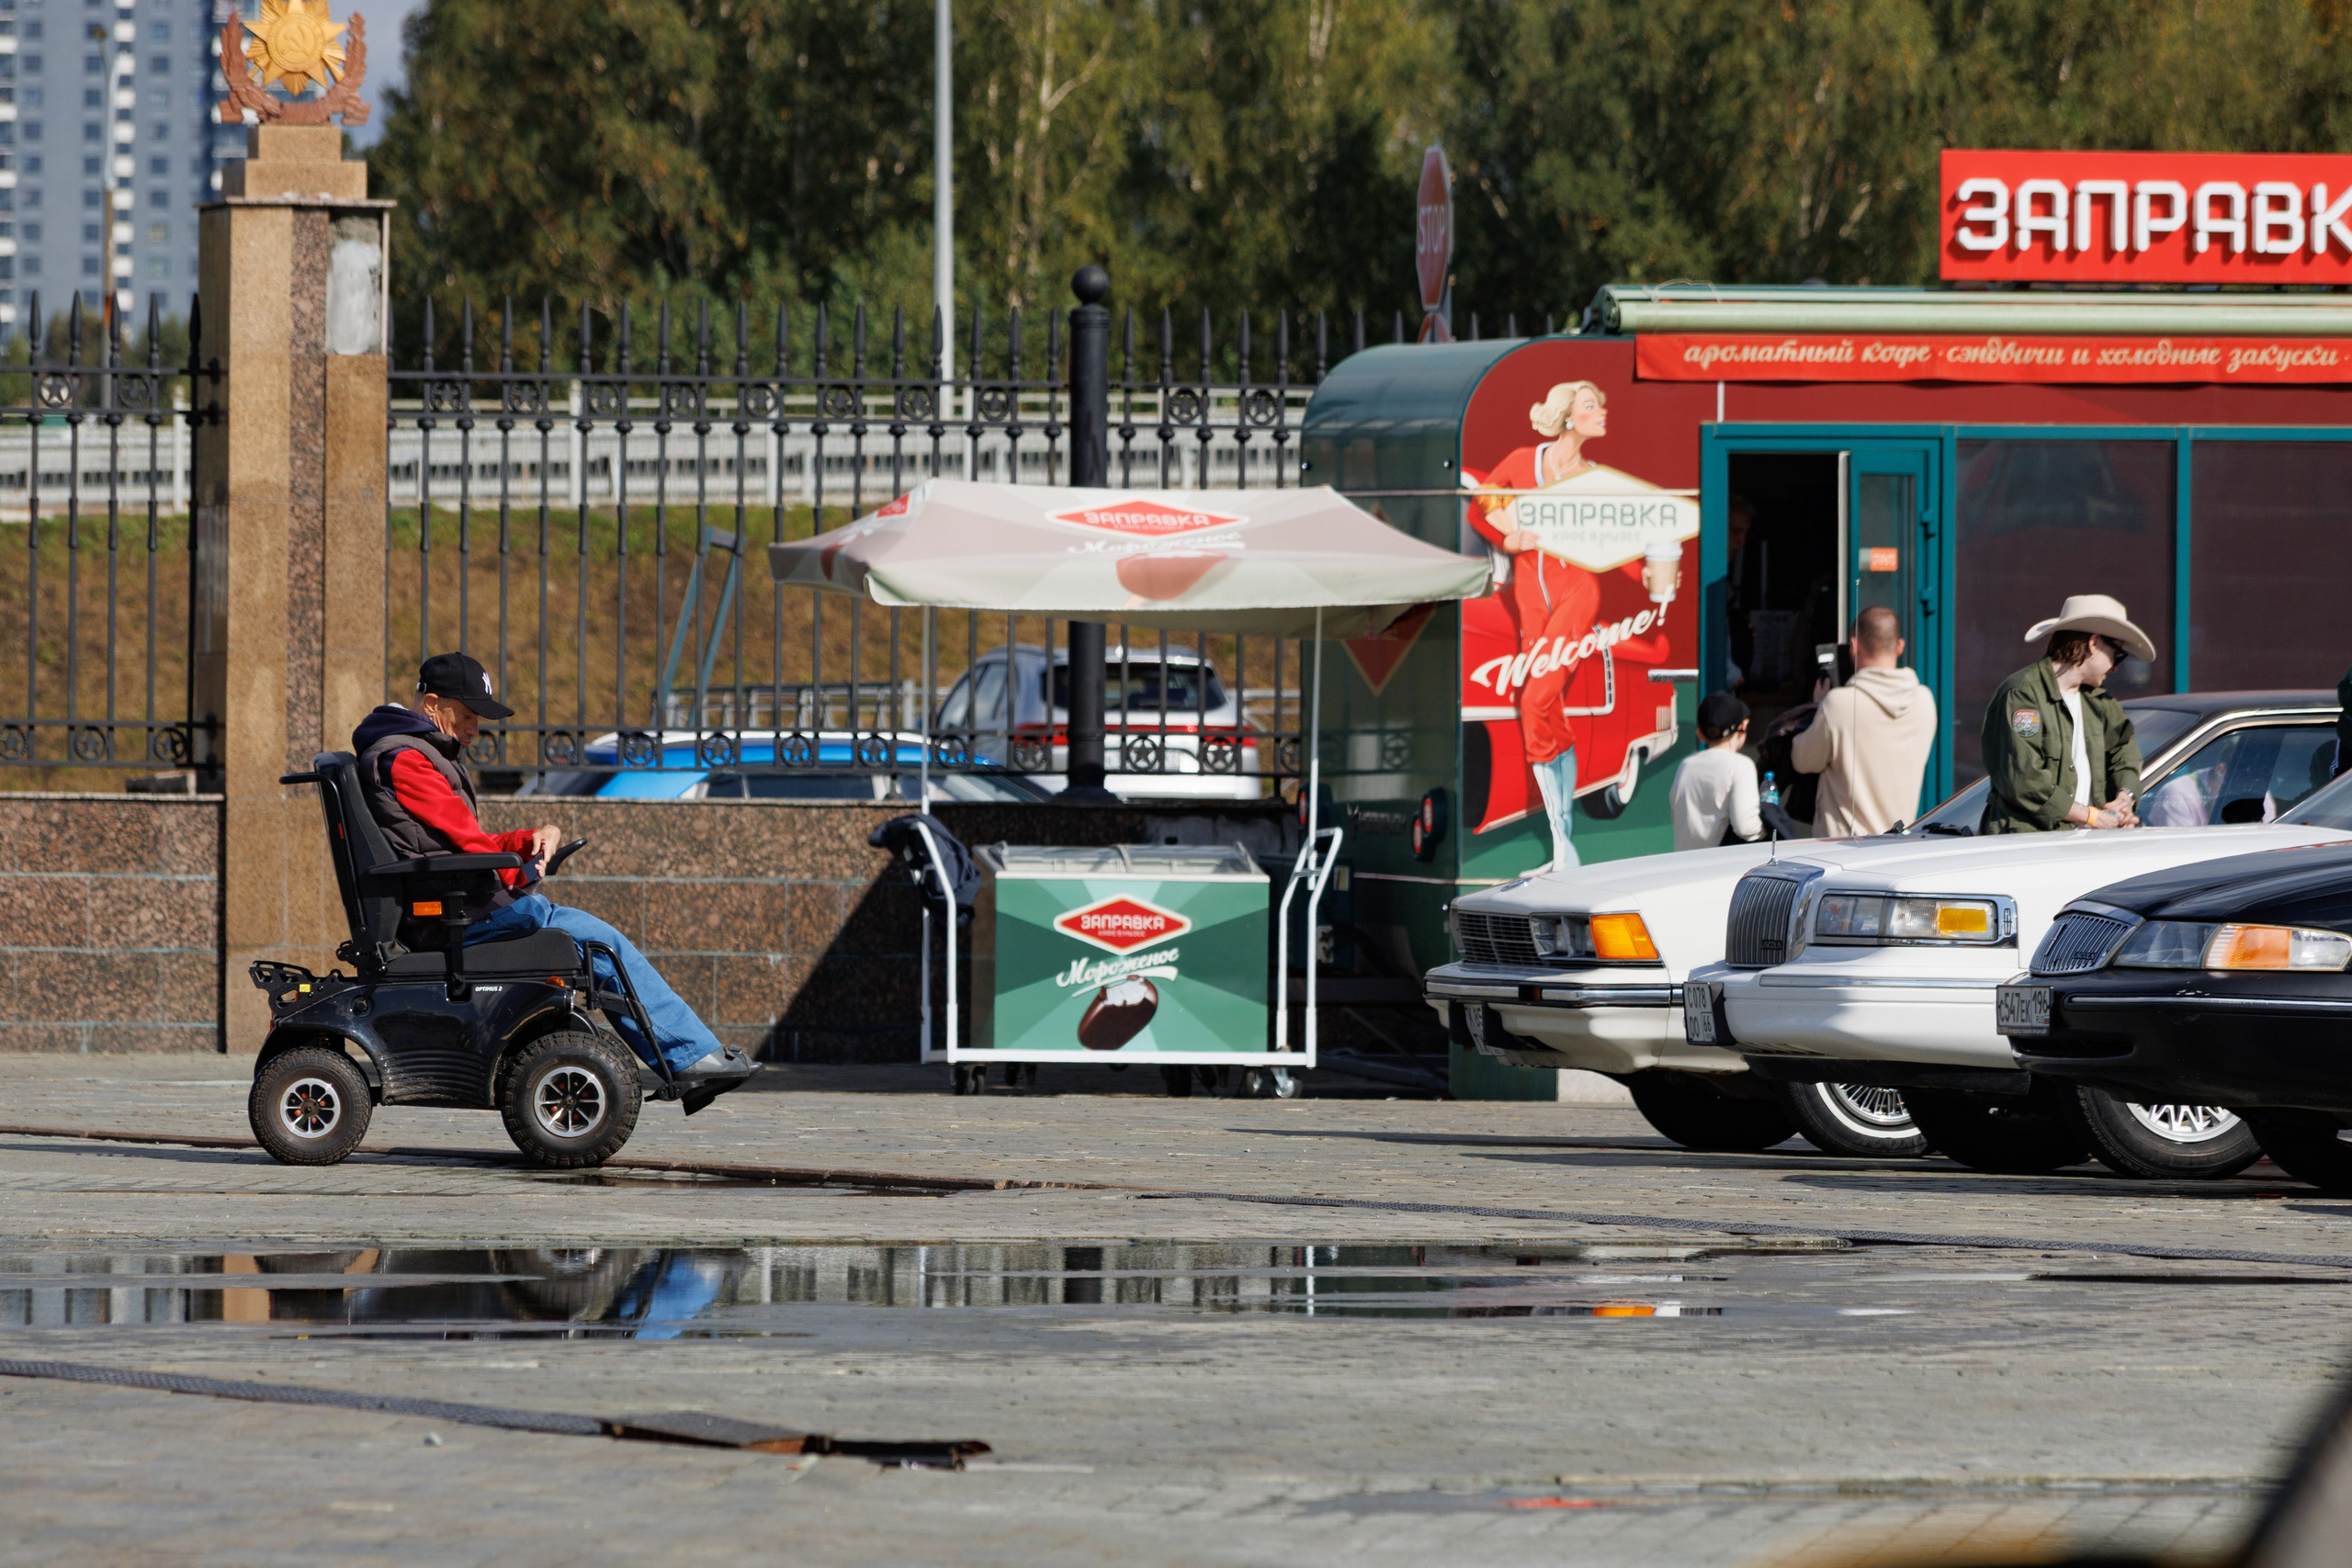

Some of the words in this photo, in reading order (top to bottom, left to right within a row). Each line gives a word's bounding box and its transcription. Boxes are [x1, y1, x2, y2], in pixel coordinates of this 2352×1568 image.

[1419, 205, 1445, 254] STOP
[1683, 340, 1855, 370] ароматный
[1860, 342, 1932, 368] кофе
[1946, 336, 2064, 366] сэндвичи
[2071, 346, 2092, 366] и
[2096, 338, 2222, 366] холодные
[2224, 344, 2339, 375] закуски
[1083, 511, 1211, 526] ЗАПРАВКА
[1520, 502, 1678, 527] ЗАПРАВКА
[1470, 583, 1675, 696] Welcome!
[1080, 914, 1166, 931] ЗАПРАВКА
[1056, 947, 1180, 987] Мороженое
[2032, 990, 2049, 1015] 196
[1702, 1015, 1712, 1032] 66
